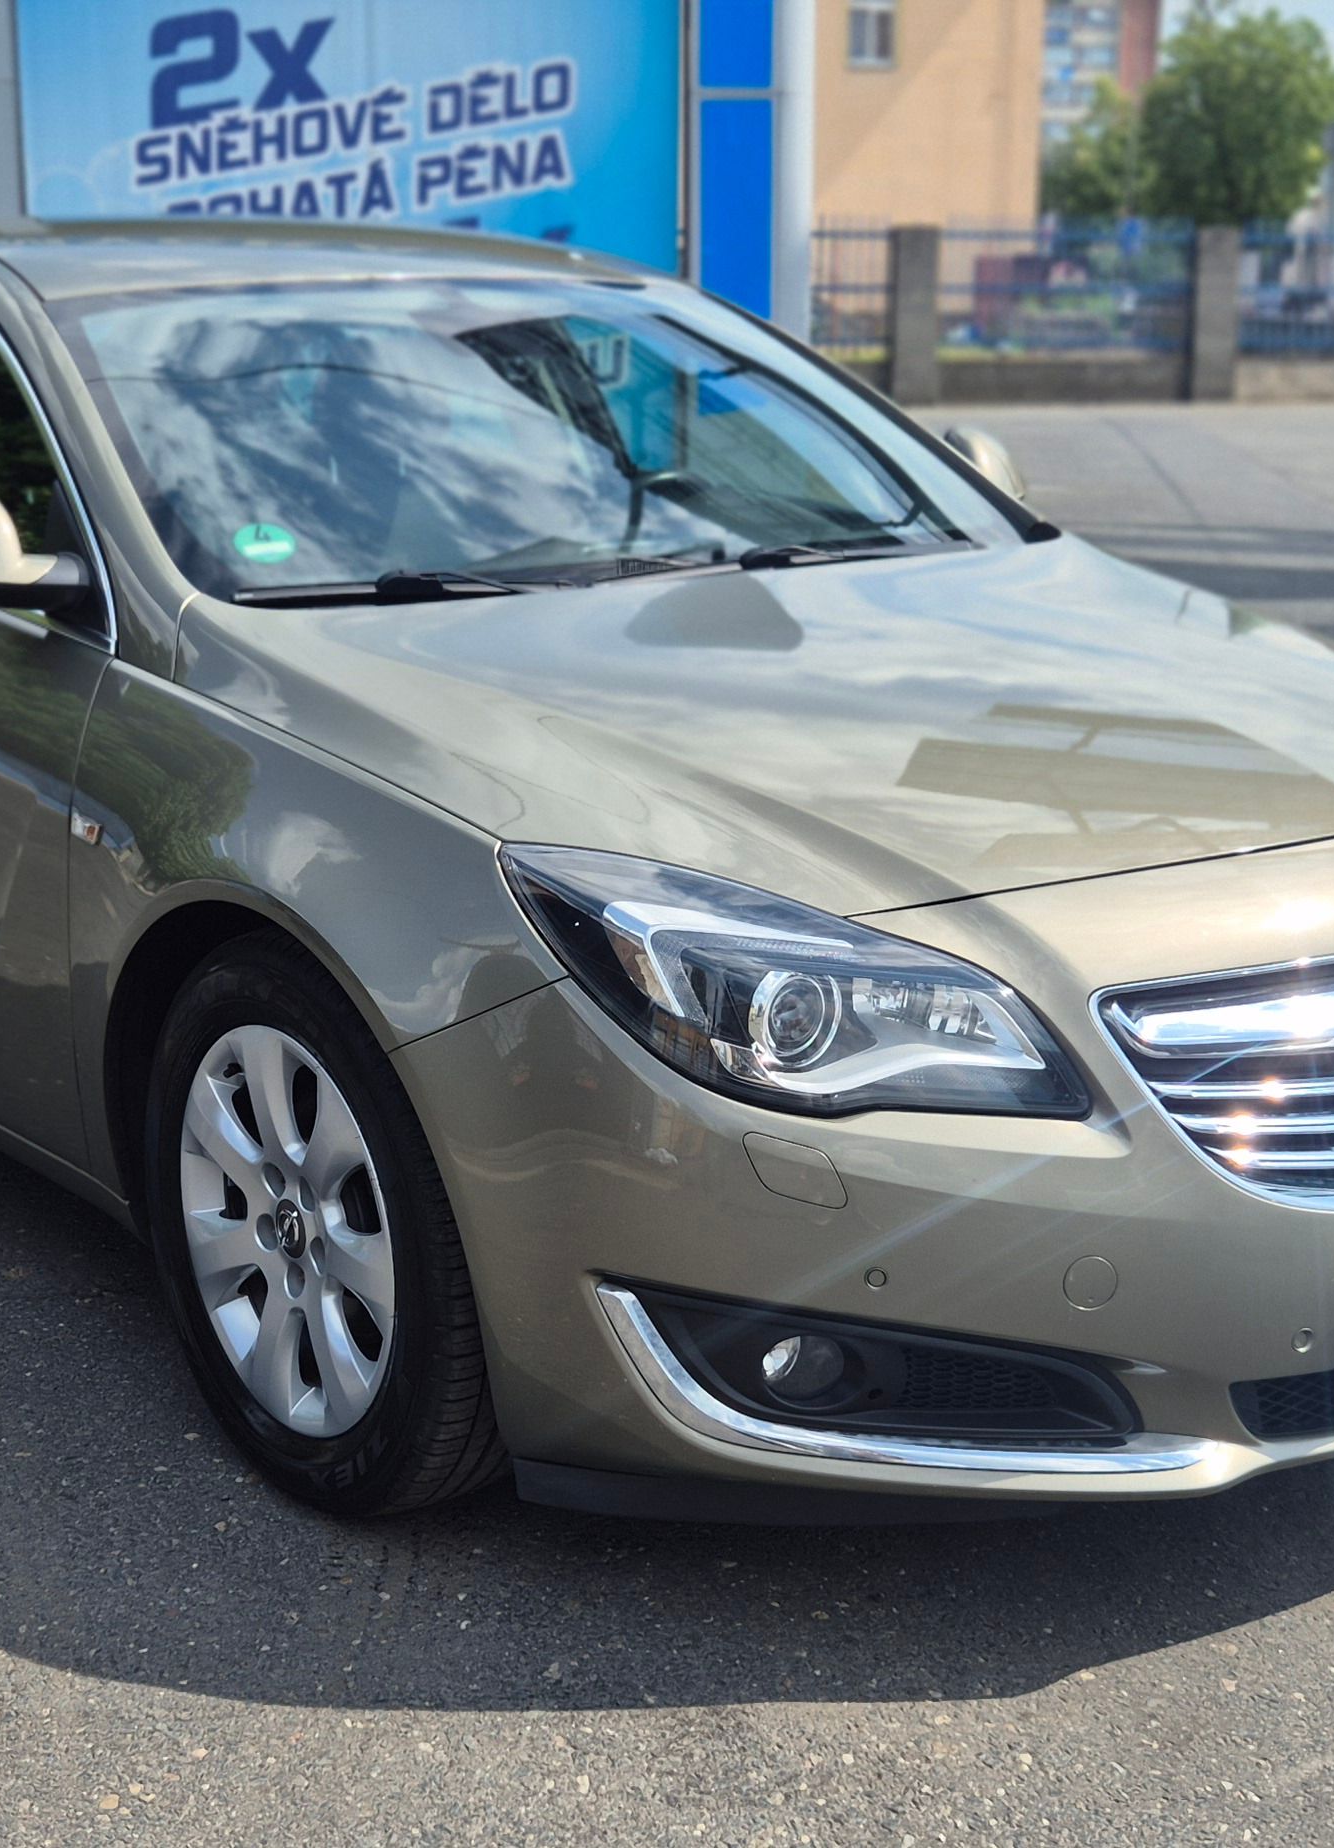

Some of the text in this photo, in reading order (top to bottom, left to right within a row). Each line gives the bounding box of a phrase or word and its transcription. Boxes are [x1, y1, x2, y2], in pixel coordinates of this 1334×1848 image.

[136, 62, 571, 186] SNĚHOVÉ DĚLO
[150, 8, 335, 127] 2x
[167, 135, 567, 217] HATÁ PĚNA
